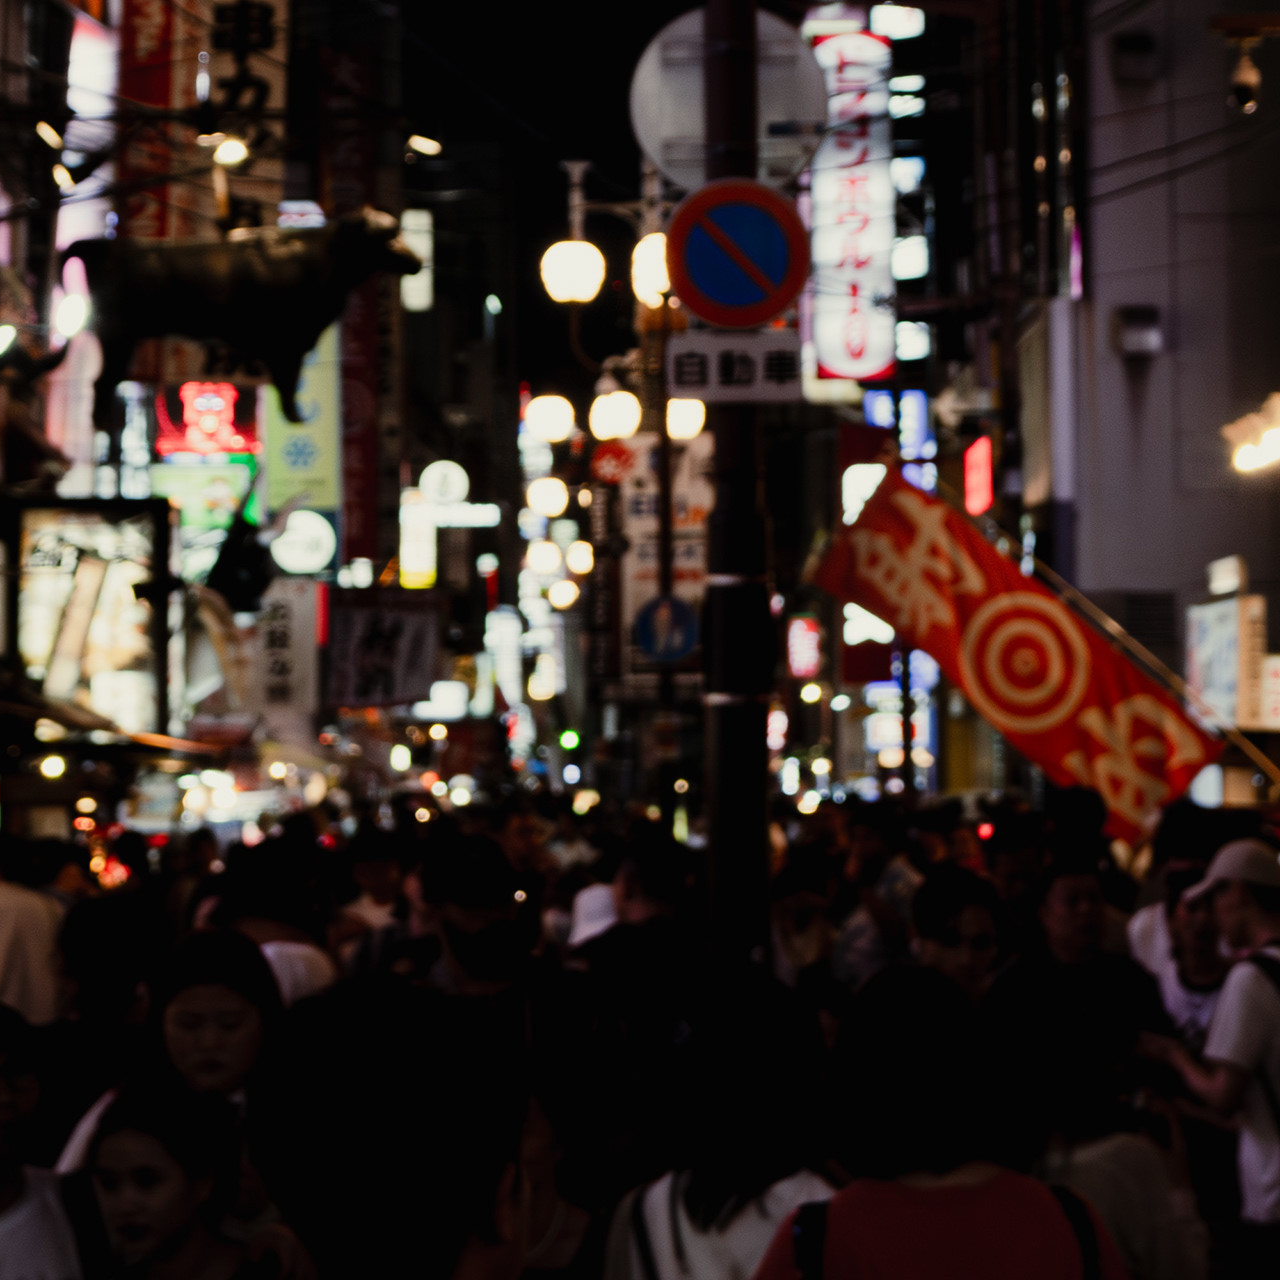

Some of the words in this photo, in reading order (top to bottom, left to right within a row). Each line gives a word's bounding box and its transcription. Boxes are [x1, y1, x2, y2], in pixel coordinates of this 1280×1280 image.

[673, 349, 799, 388] 自動車
[850, 488, 1208, 830] 射的
